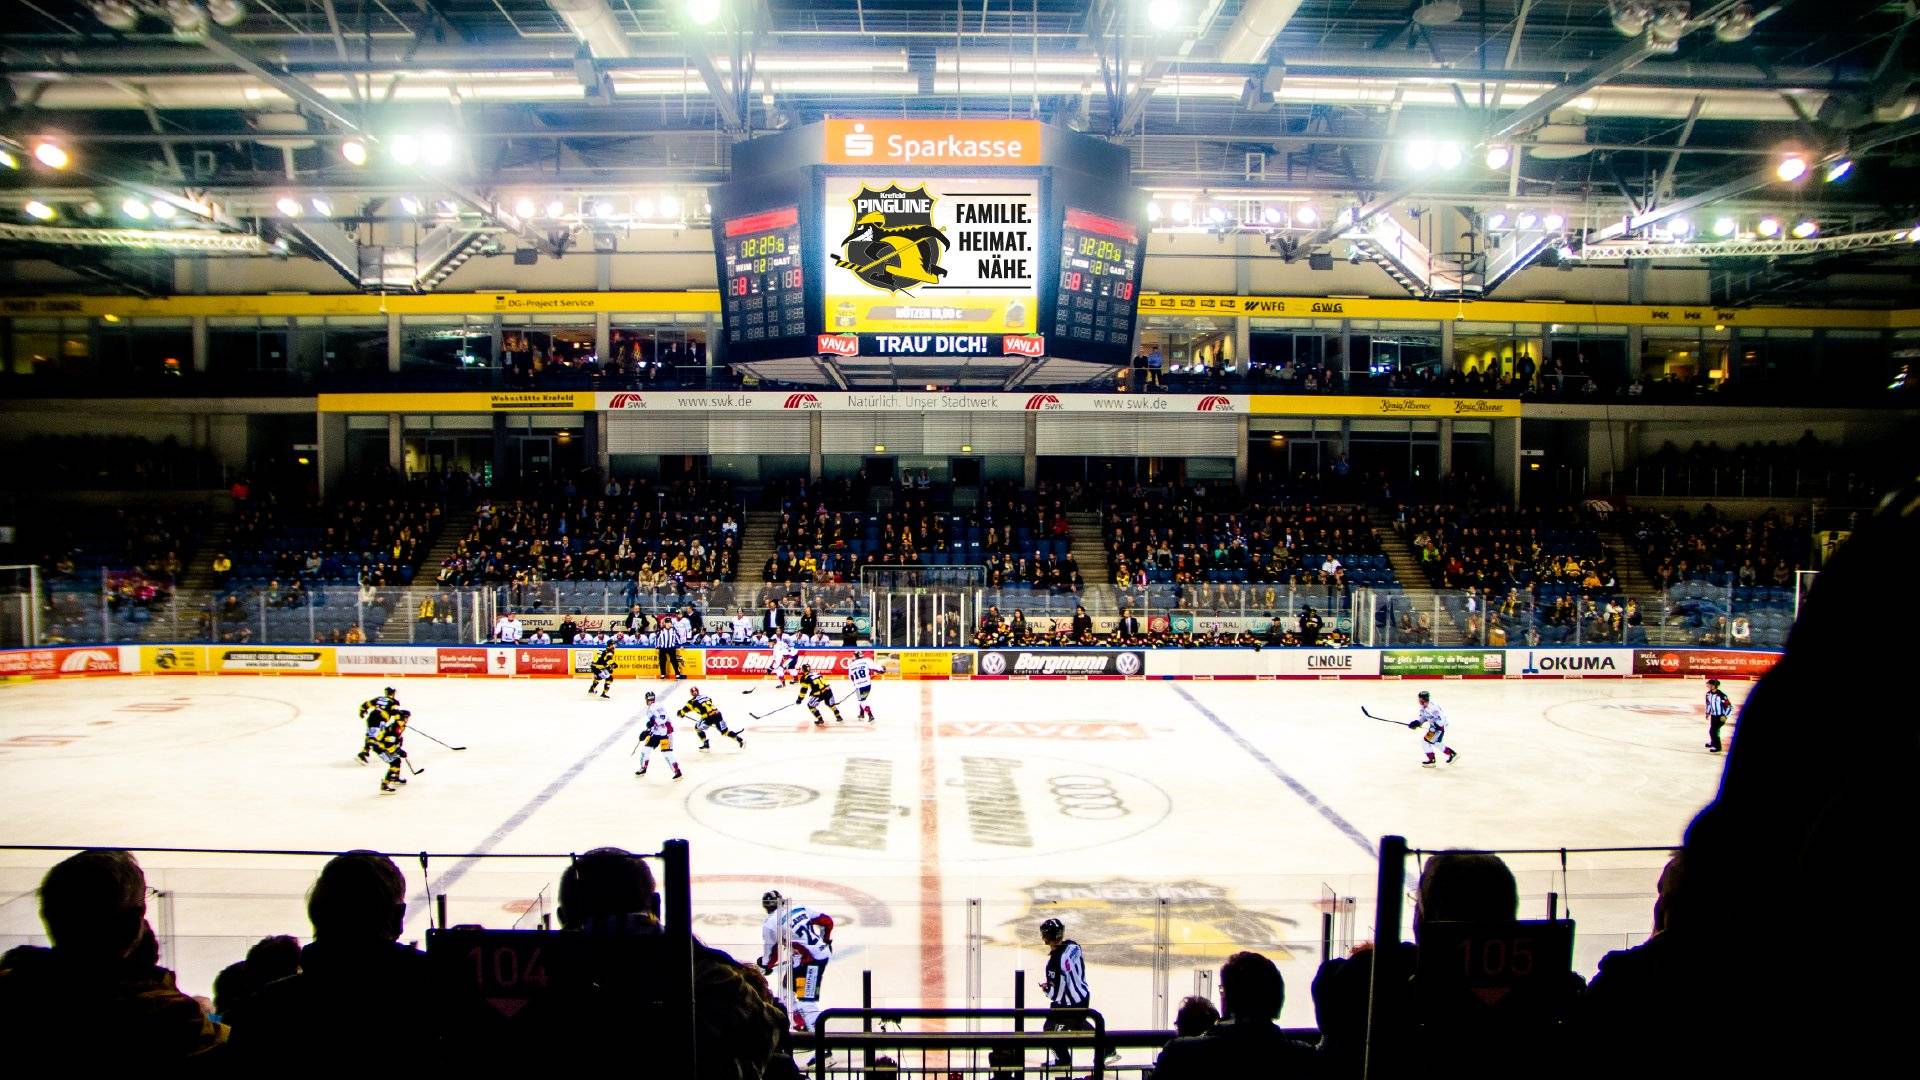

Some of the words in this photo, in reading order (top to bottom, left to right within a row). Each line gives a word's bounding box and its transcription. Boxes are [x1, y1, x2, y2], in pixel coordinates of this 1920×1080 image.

[887, 134, 1023, 161] Sparkasse
[857, 199, 930, 213] PINGUINE
[956, 203, 1032, 224] FAMILIE.
[959, 231, 1032, 252] HEIMAT.
[978, 254, 1032, 279] NÄHE.
[508, 299, 558, 308] DG-Project
[560, 299, 594, 307] Service
[1261, 301, 1285, 311] WFG
[1311, 303, 1343, 313] GWG
[876, 335, 931, 353] TRAU'
[935, 336, 987, 353] DICH!
[491, 394, 541, 402] Wohnstätte
[678, 394, 752, 407] www.swk.de
[848, 394, 901, 408] Natürlich.
[905, 395, 937, 408] Unser
[941, 395, 999, 408] Stadtwerk
[1093, 397, 1168, 410] www.swk.de
[627, 401, 647, 409] SWK
[802, 401, 822, 409] SWK
[89, 661, 119, 671] SWK
[1307, 655, 1353, 667] CINQUE
[1540, 656, 1616, 670] OKUMA
[1689, 656, 1711, 666] Bringt
[1711, 657, 1722, 665] Sie
[1724, 657, 1748, 666] nachts
[1458, 936, 1537, 977] 105
[467, 944, 555, 990] 104
